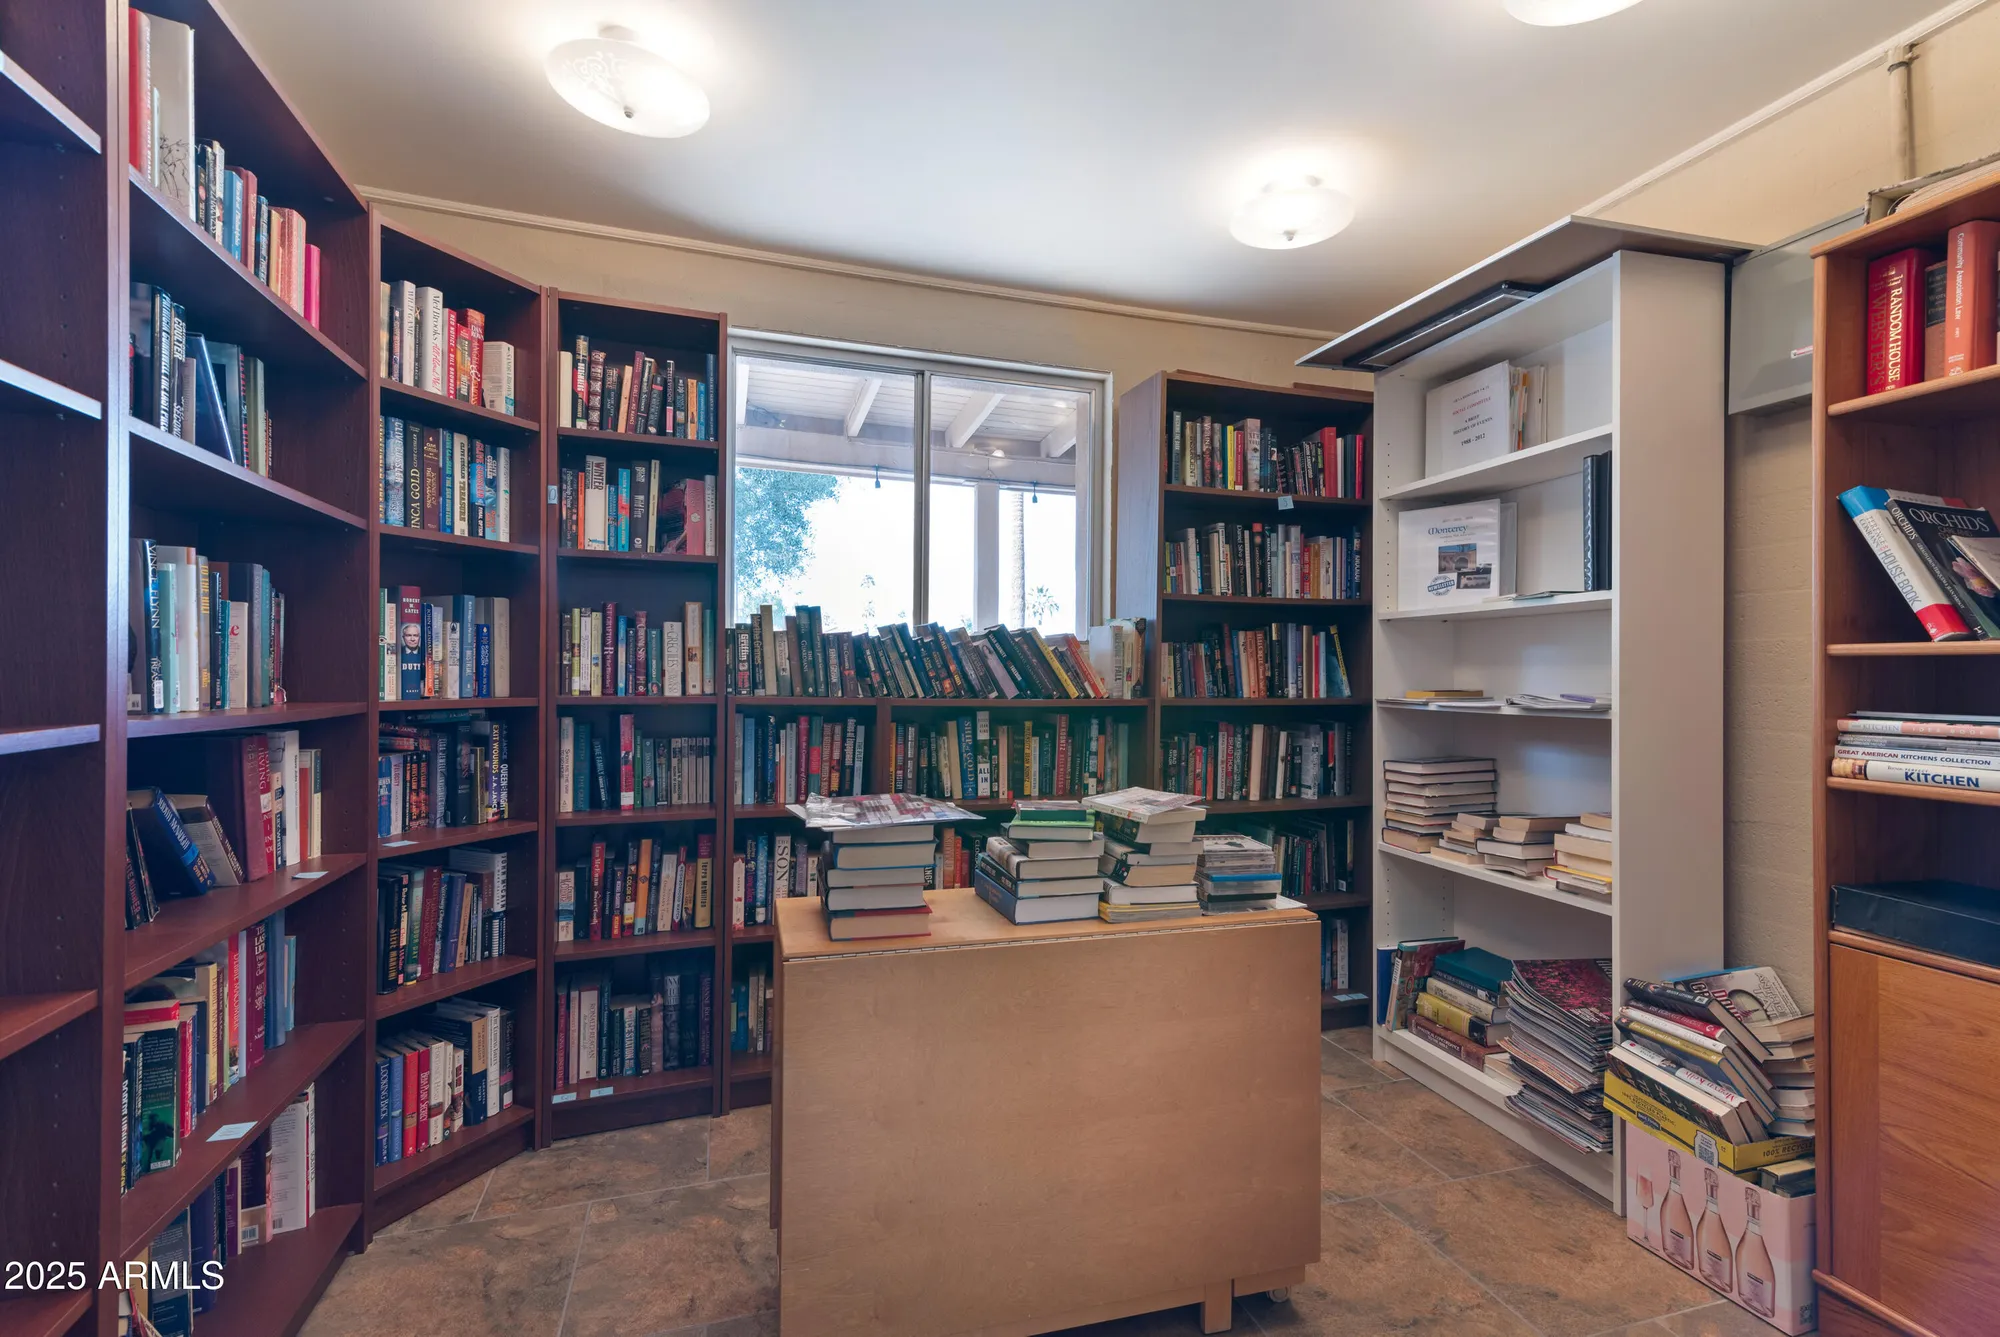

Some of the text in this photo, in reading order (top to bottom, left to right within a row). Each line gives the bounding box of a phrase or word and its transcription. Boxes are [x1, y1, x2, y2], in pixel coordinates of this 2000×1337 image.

[1954, 232, 1965, 320] Community Association Law
[406, 290, 414, 312] WILD
[432, 294, 440, 341] Mel Brooks
[173, 317, 182, 361] COULTER
[1870, 293, 1887, 386] WEBSTER'S
[1888, 287, 1904, 382] RANDOM HOUSE
[1467, 397, 1491, 409] COMMITTEE
[1453, 426, 1470, 435] HISTORY
[1477, 417, 1493, 426] EVENTS
[1461, 438, 1472, 446] 1988
[1475, 433, 1486, 441] 2012
[395, 422, 403, 483] CLIVE CUSSLER
[476, 441, 484, 463] CLIVE
[476, 465, 484, 498] CUSSLER
[593, 462, 603, 490] WINTER
[411, 469, 420, 528] INCA GOLD
[634, 495, 644, 518] Wild Fire
[1428, 525, 1467, 535] Monterey
[1859, 518, 1880, 548] CONRAN
[1866, 515, 1886, 545] TERENCE
[1891, 507, 1917, 541] ORCHIDS
[1909, 507, 1990, 532] ORCHIDS
[149, 545, 160, 629] VINCE FLYNN
[201, 565, 210, 615] TO THE HILT
[1428, 580, 1455, 592] NEWSLETTER
[1879, 549, 1922, 607] HOUSE BOOK
[667, 631, 679, 653] GREG
[753, 616, 761, 640] Martha
[964, 721, 973, 744] SHIP
[1862, 724, 1900, 732] KITCHEN
[258, 748, 266, 790] IRVING
[595, 745, 605, 775] THE FAMILY
[966, 753, 974, 781] GOLD
[1861, 751, 1899, 759] AMERICAN
[1901, 754, 1938, 762] KITCHENS
[1940, 757, 1991, 765] COLLECTION
[393, 763, 401, 786] VELOCITY
[500, 764, 508, 811] QUEEN NIGHT
[831, 772, 840, 792] GONE
[1904, 772, 1980, 788] KITCHEN
[700, 862, 708, 879] Terry
[776, 845, 788, 881] SON
[388, 929, 398, 981] STEVE MARTINI
[625, 1020, 634, 1060] ICE STATION
[381, 1064, 389, 1119] LOOKING BACK
[1763, 1143, 1813, 1158] 100% RECYCLE
